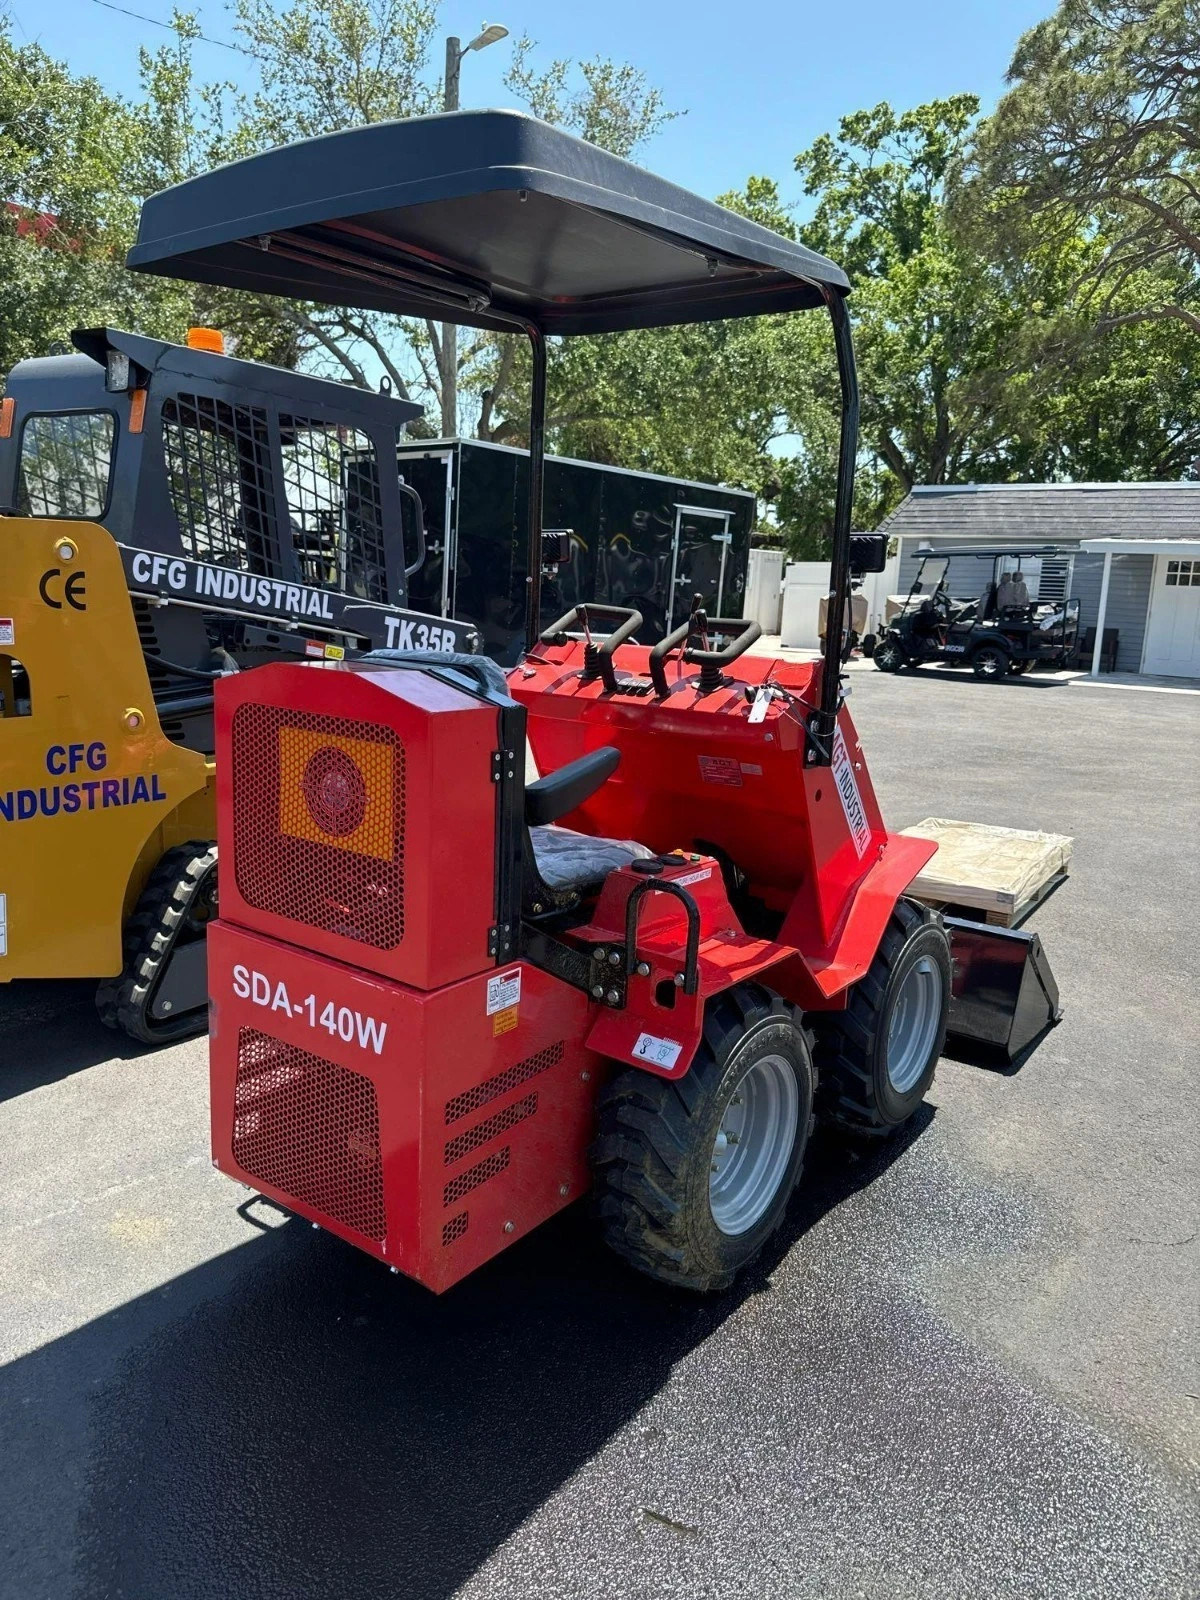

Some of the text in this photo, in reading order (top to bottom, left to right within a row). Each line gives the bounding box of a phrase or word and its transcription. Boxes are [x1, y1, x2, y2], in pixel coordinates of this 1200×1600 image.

[39, 568, 86, 611] CE
[132, 553, 335, 620] CFG INDUSTRIAL
[46, 742, 107, 775] CFG
[0, 775, 167, 821] NDUSTRIAL
[233, 964, 388, 1055] SDA-140W
